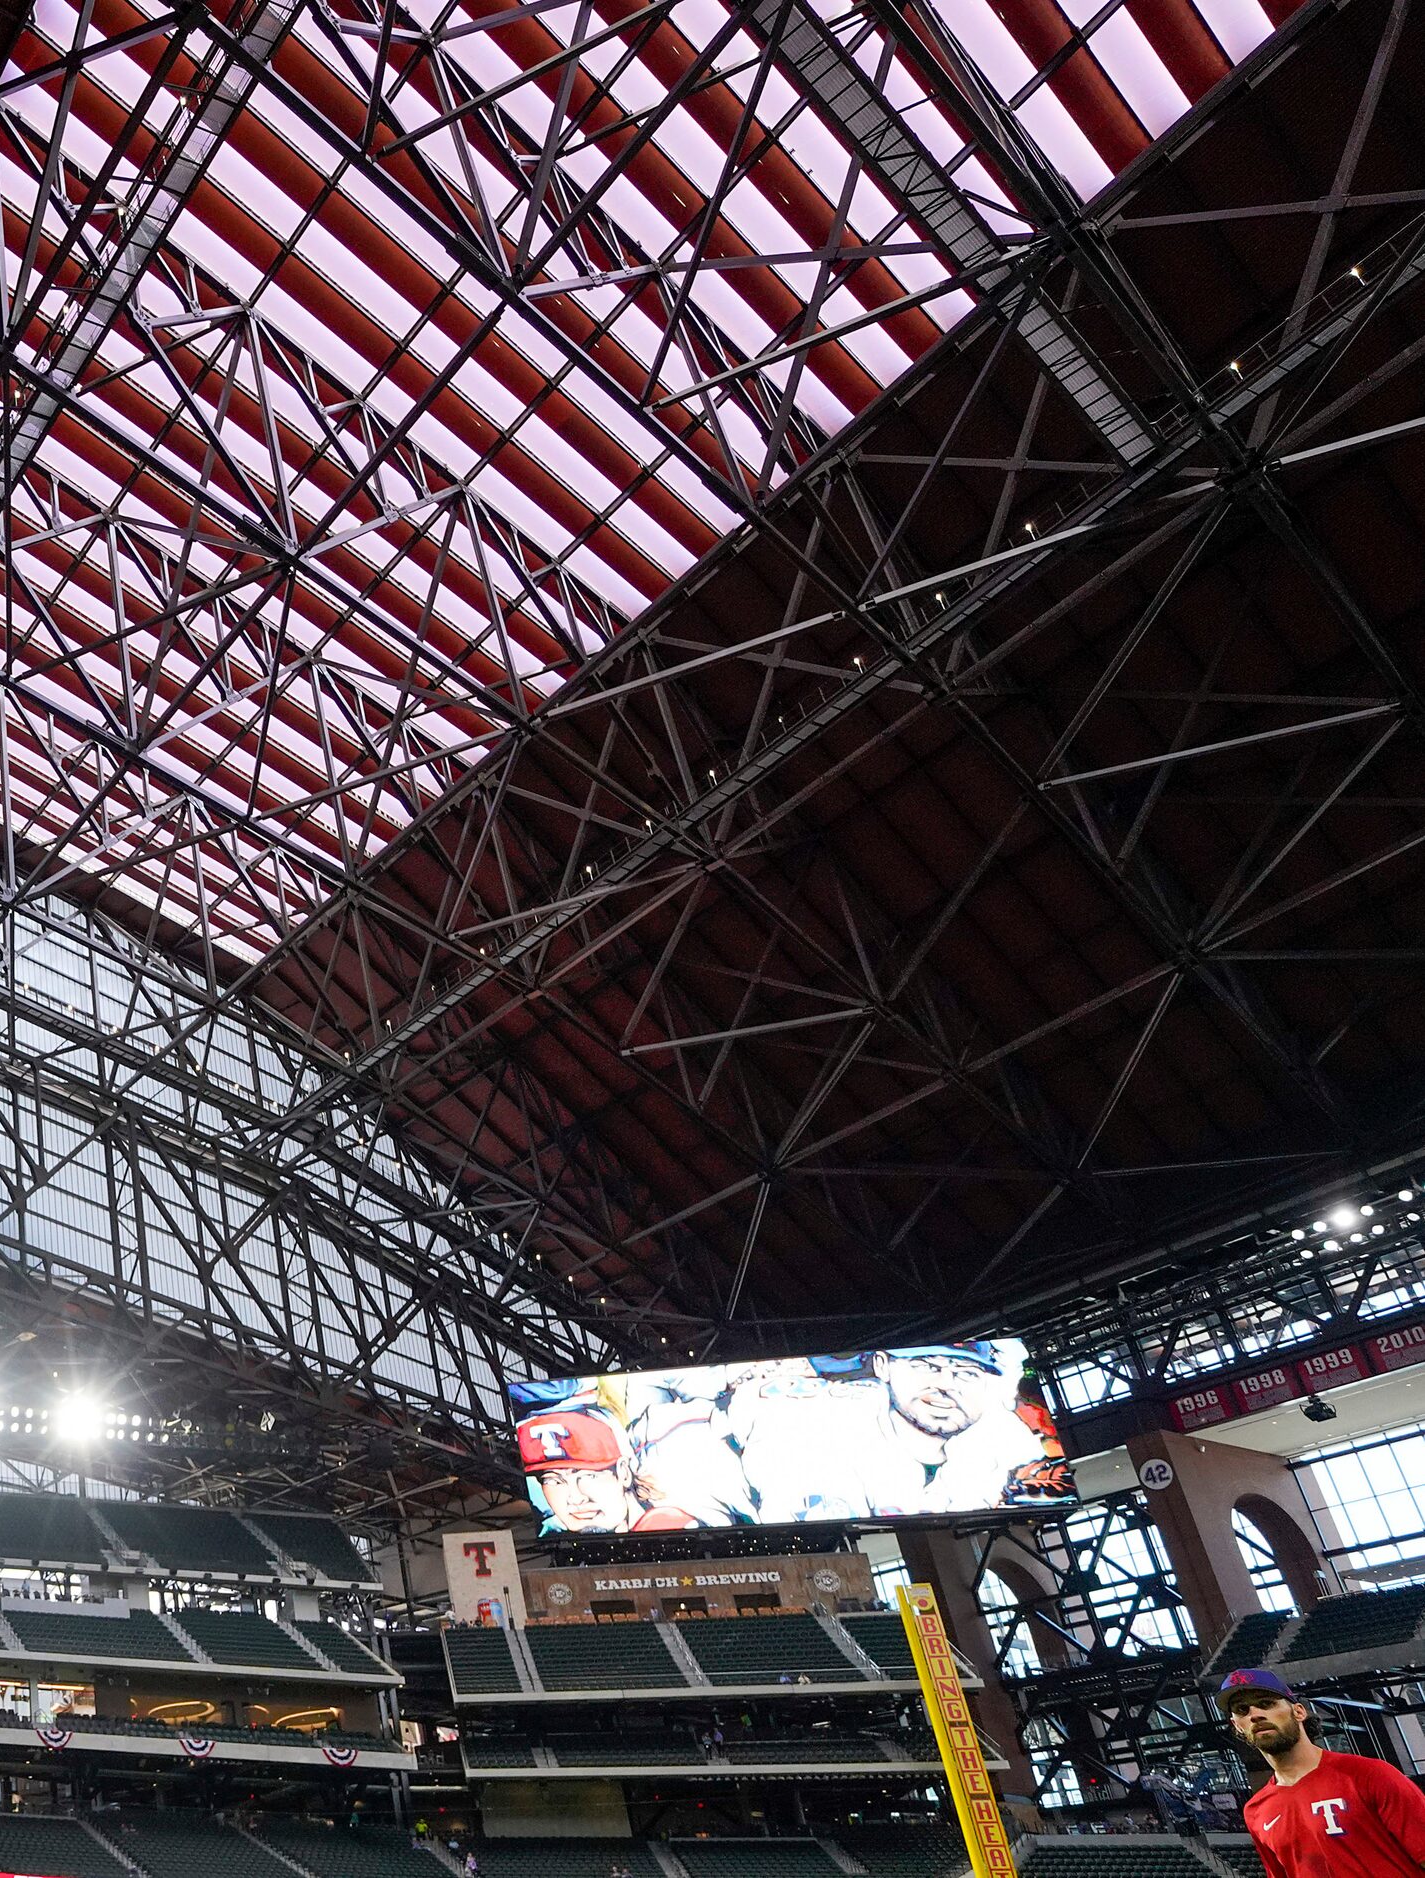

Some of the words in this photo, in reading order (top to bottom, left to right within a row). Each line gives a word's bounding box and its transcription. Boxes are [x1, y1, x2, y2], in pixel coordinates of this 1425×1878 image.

[1377, 1326, 1425, 1353] 2010
[1304, 1348, 1353, 1375] 1999
[1239, 1369, 1286, 1394] 1998
[1175, 1390, 1219, 1414] 1996
[530, 1424, 570, 1460] T
[1145, 1464, 1171, 1483] 42
[463, 1541, 496, 1577] T
[695, 1571, 781, 1587] BREWING
[922, 1616, 962, 1719] BRING
[954, 1729, 985, 1792] THE
[1311, 1798, 1346, 1836] T
